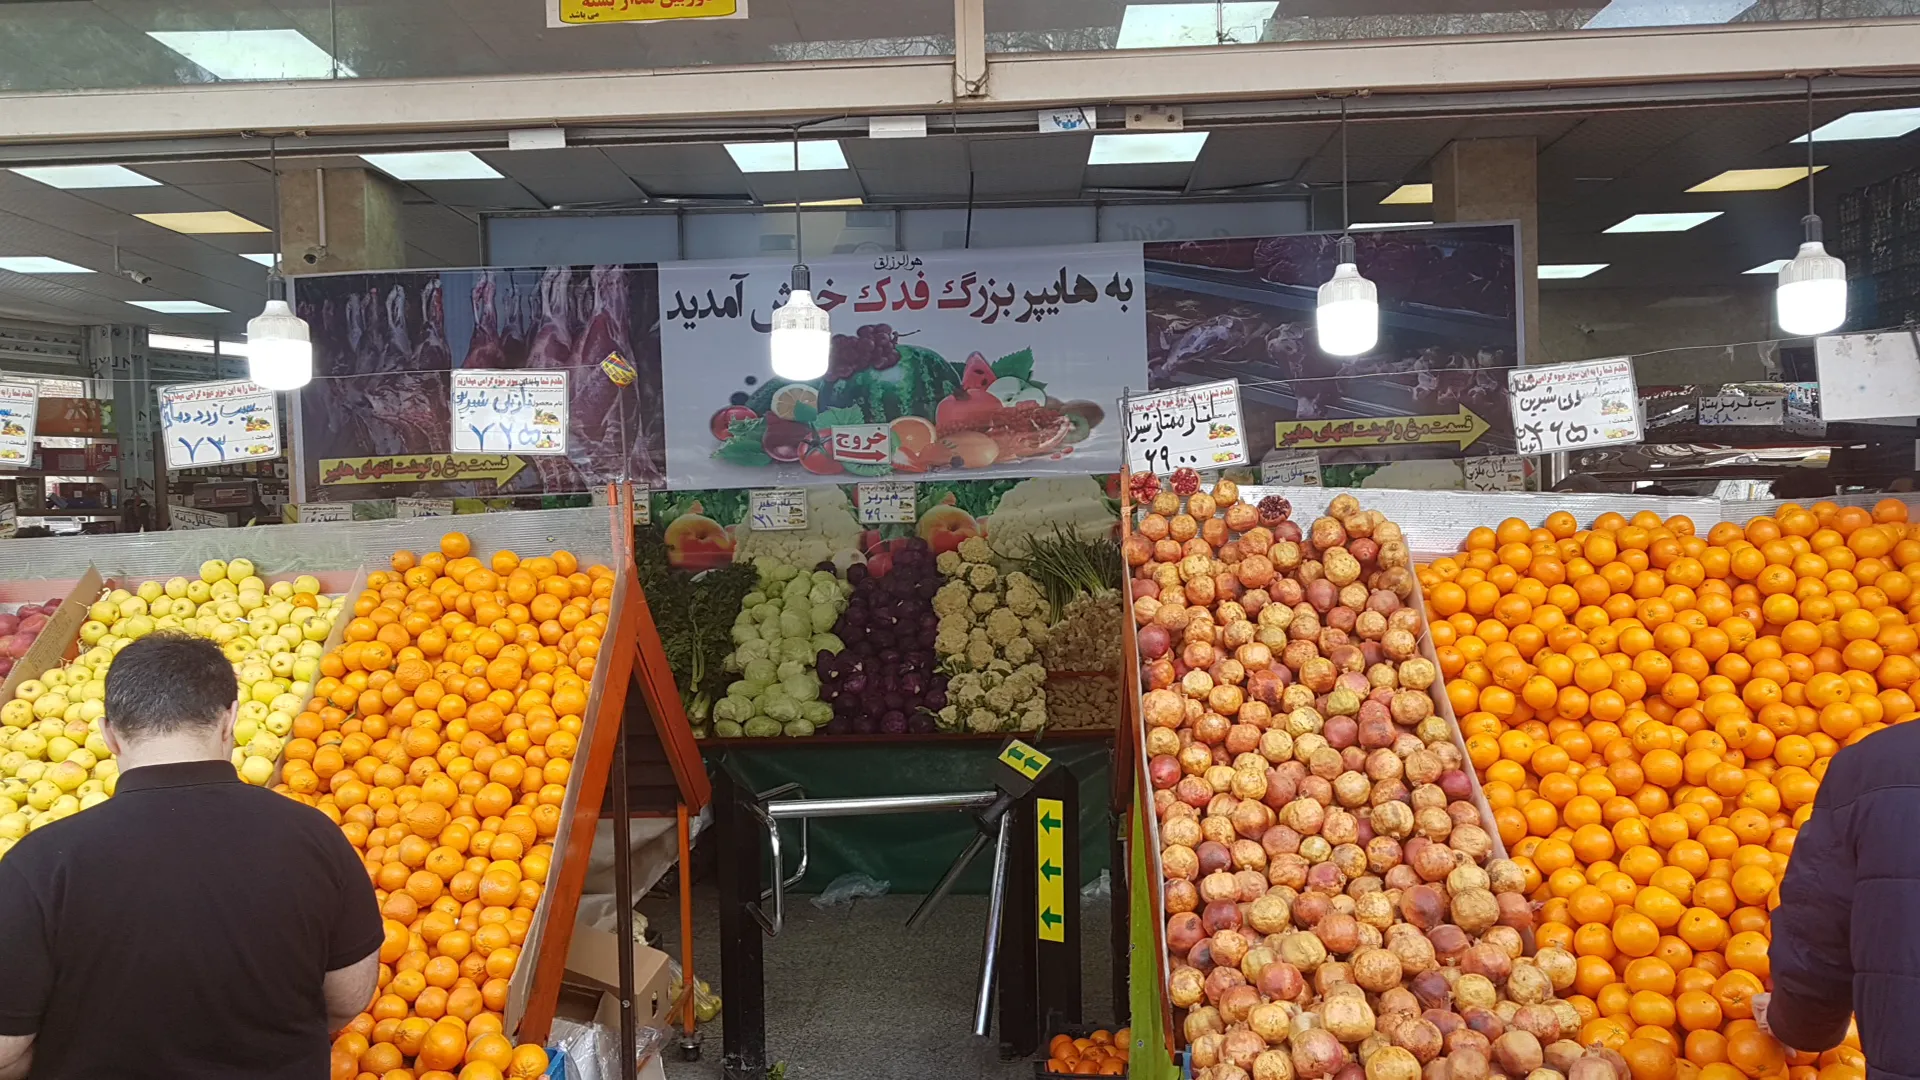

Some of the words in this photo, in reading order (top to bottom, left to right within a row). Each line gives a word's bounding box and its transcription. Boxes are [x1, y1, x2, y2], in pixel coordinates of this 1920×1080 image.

[569, 11, 586, 19] باشد
[587, 12, 600, 20] می
[666, 273, 750, 330] آمدید
[854, 269, 930, 313] فدک
[937, 272, 1016, 324] بزرگ
[1015, 266, 1098, 323] هایپر
[1105, 271, 1134, 314] به
[751, 276, 847, 334] خش
[1520, 386, 1557, 417] شیرین
[1718, 397, 1753, 413] قرمز
[1754, 399, 1776, 410] سیب
[193, 403, 218, 427] زرد
[220, 402, 256, 425] سیب
[1153, 407, 1185, 443] ممتاز
[1182, 390, 1214, 437] انار
[1431, 415, 1473, 434] قسمت
[836, 427, 887, 450] خروج
[1354, 420, 1394, 442] گوشت
[1394, 422, 1403, 440] و
[1403, 418, 1429, 441] مرغ
[394, 457, 431, 479] گوشت
[431, 460, 440, 477] و
[441, 455, 467, 479] مرغ
[467, 455, 509, 472] قسمت
[1145, 445, 1197, 472] ۶۹۰۰
